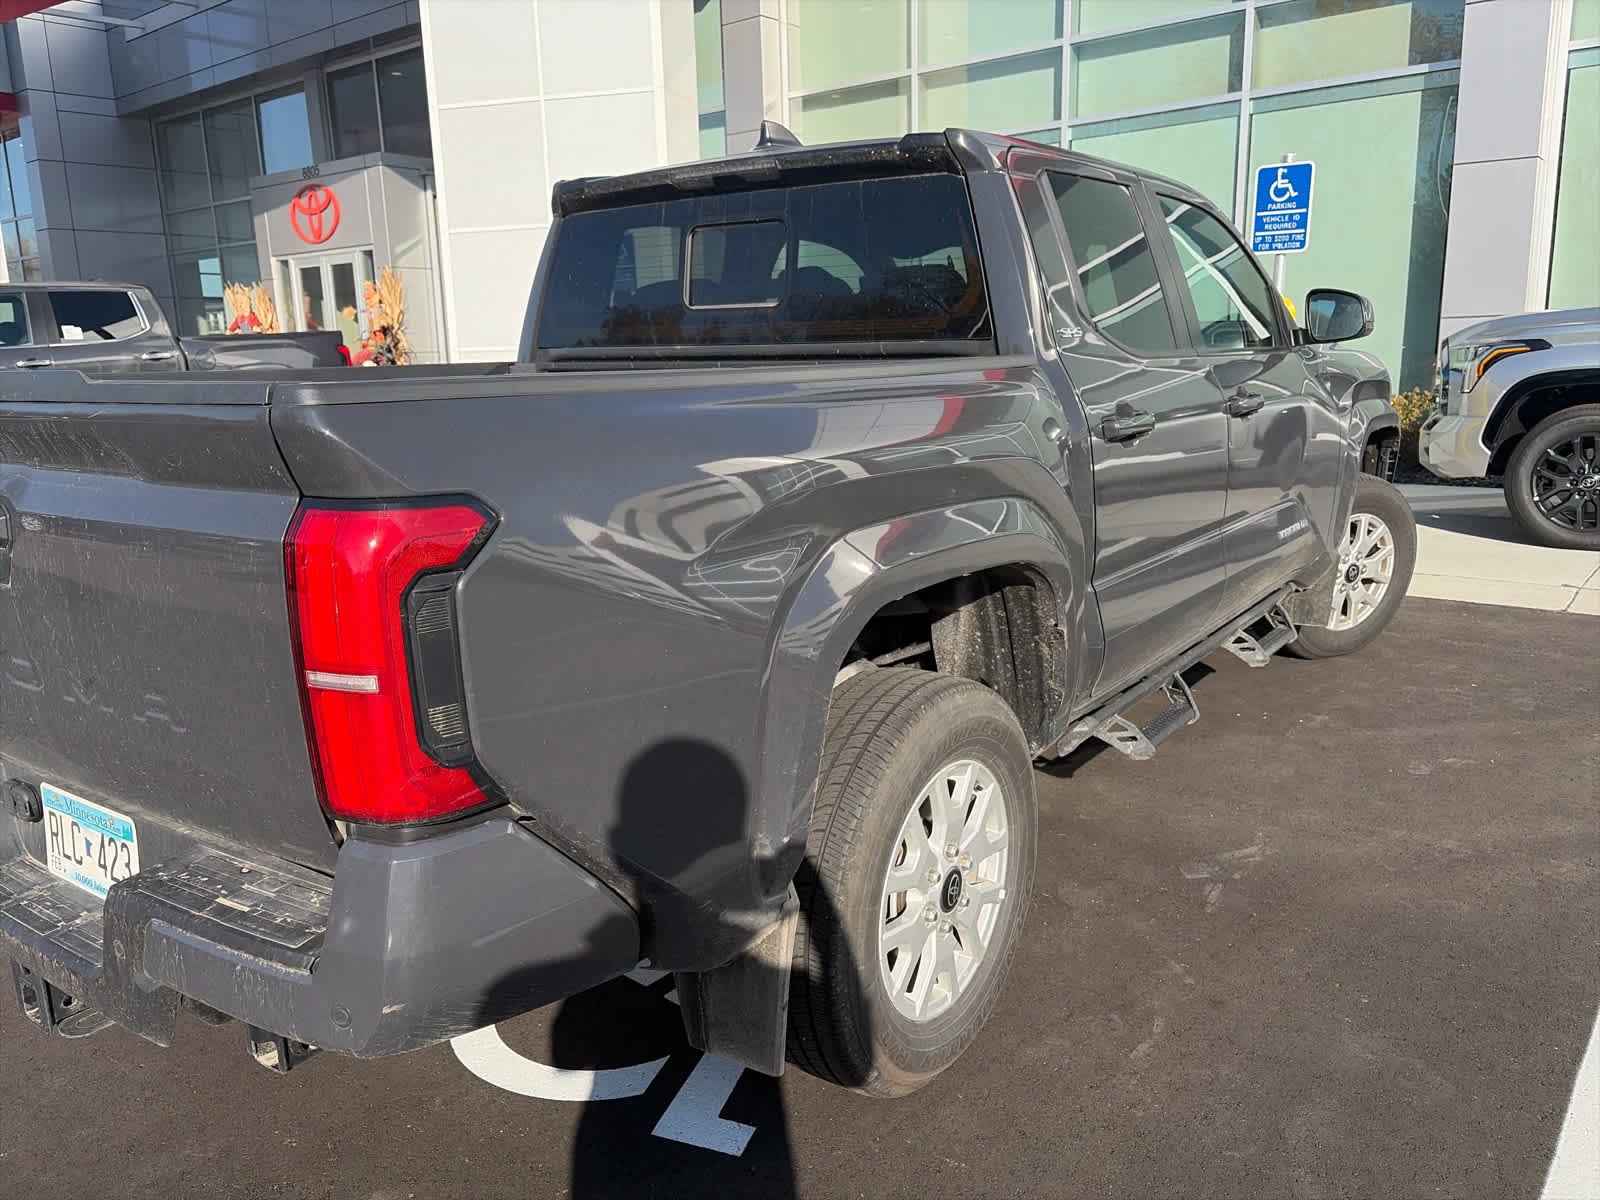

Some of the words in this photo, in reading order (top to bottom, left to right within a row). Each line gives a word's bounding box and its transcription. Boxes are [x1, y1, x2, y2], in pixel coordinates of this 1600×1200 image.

[1267, 202, 1297, 210] PARKING
[1262, 215, 1289, 223] VEHICLE
[1264, 222, 1297, 230] REQUIRED
[1272, 241, 1301, 250] VIOLATION
[64, 797, 110, 830] Minnesota
[48, 811, 83, 866] RLC
[98, 832, 132, 882] 423
